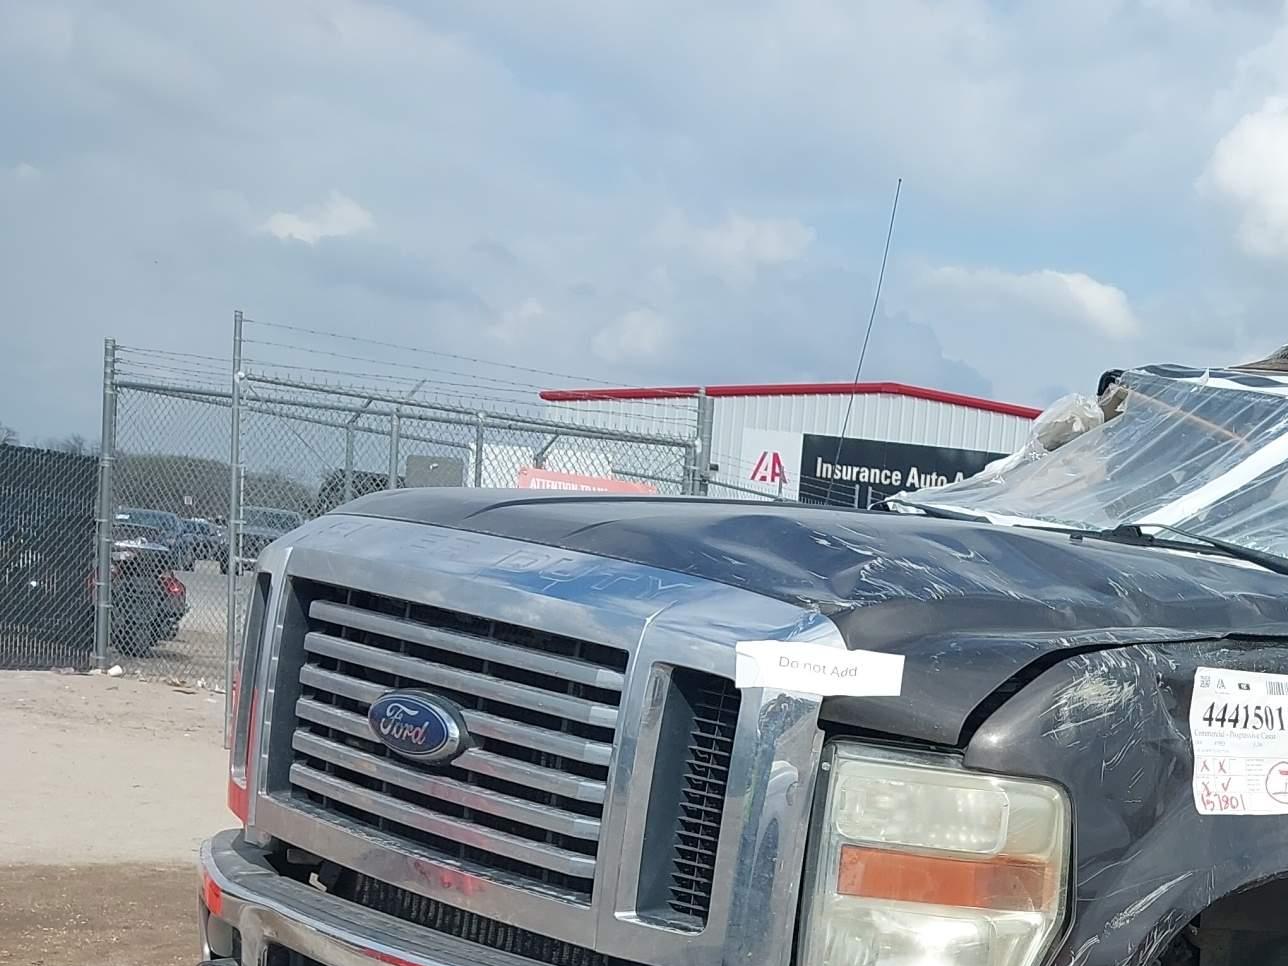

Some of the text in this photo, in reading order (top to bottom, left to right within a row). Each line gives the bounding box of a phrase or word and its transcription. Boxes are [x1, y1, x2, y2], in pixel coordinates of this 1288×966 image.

[816, 456, 901, 486] Insurance
[779, 656, 858, 679] Do not Add
[380, 702, 430, 745] Ford
